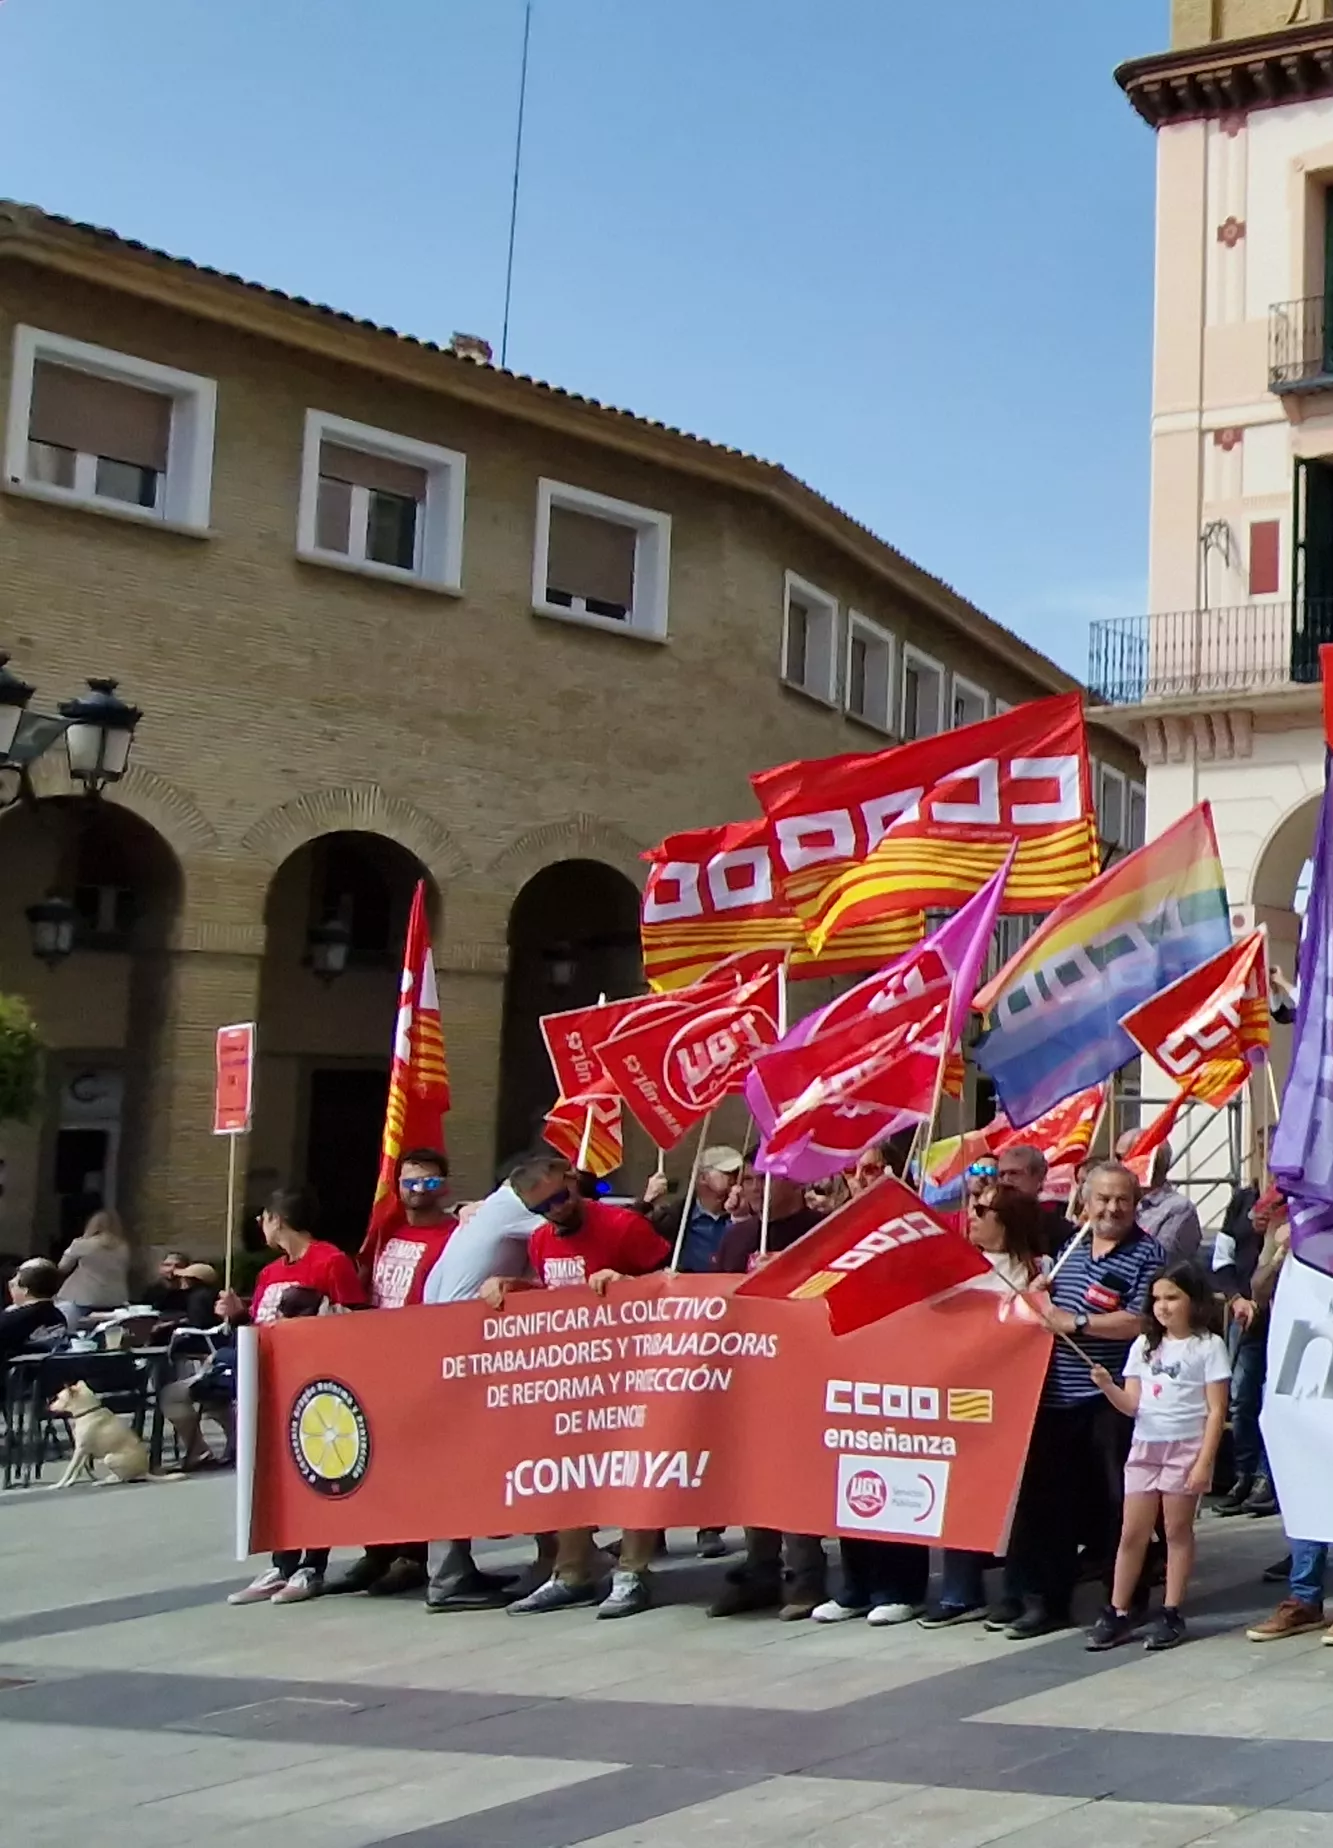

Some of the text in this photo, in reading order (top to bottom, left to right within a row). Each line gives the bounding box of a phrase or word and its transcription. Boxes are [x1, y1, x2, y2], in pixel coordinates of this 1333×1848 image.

[675, 1012, 762, 1086] UGT
[543, 1255, 587, 1279] SOMOS
[483, 1308, 590, 1340] DIGNIFICAR
[592, 1304, 618, 1328] AL
[442, 1332, 778, 1380] DE TRABAJADORES Y TRBAJADORAS
[487, 1385, 510, 1408] DE
[512, 1376, 603, 1405] REFORMA
[608, 1371, 621, 1394] Y
[825, 1379, 940, 1420] CCOO
[555, 1412, 583, 1436] DE
[824, 1427, 957, 1456] enseñanza
[643, 1450, 710, 1488] YA!
[851, 1477, 883, 1497] UGT
